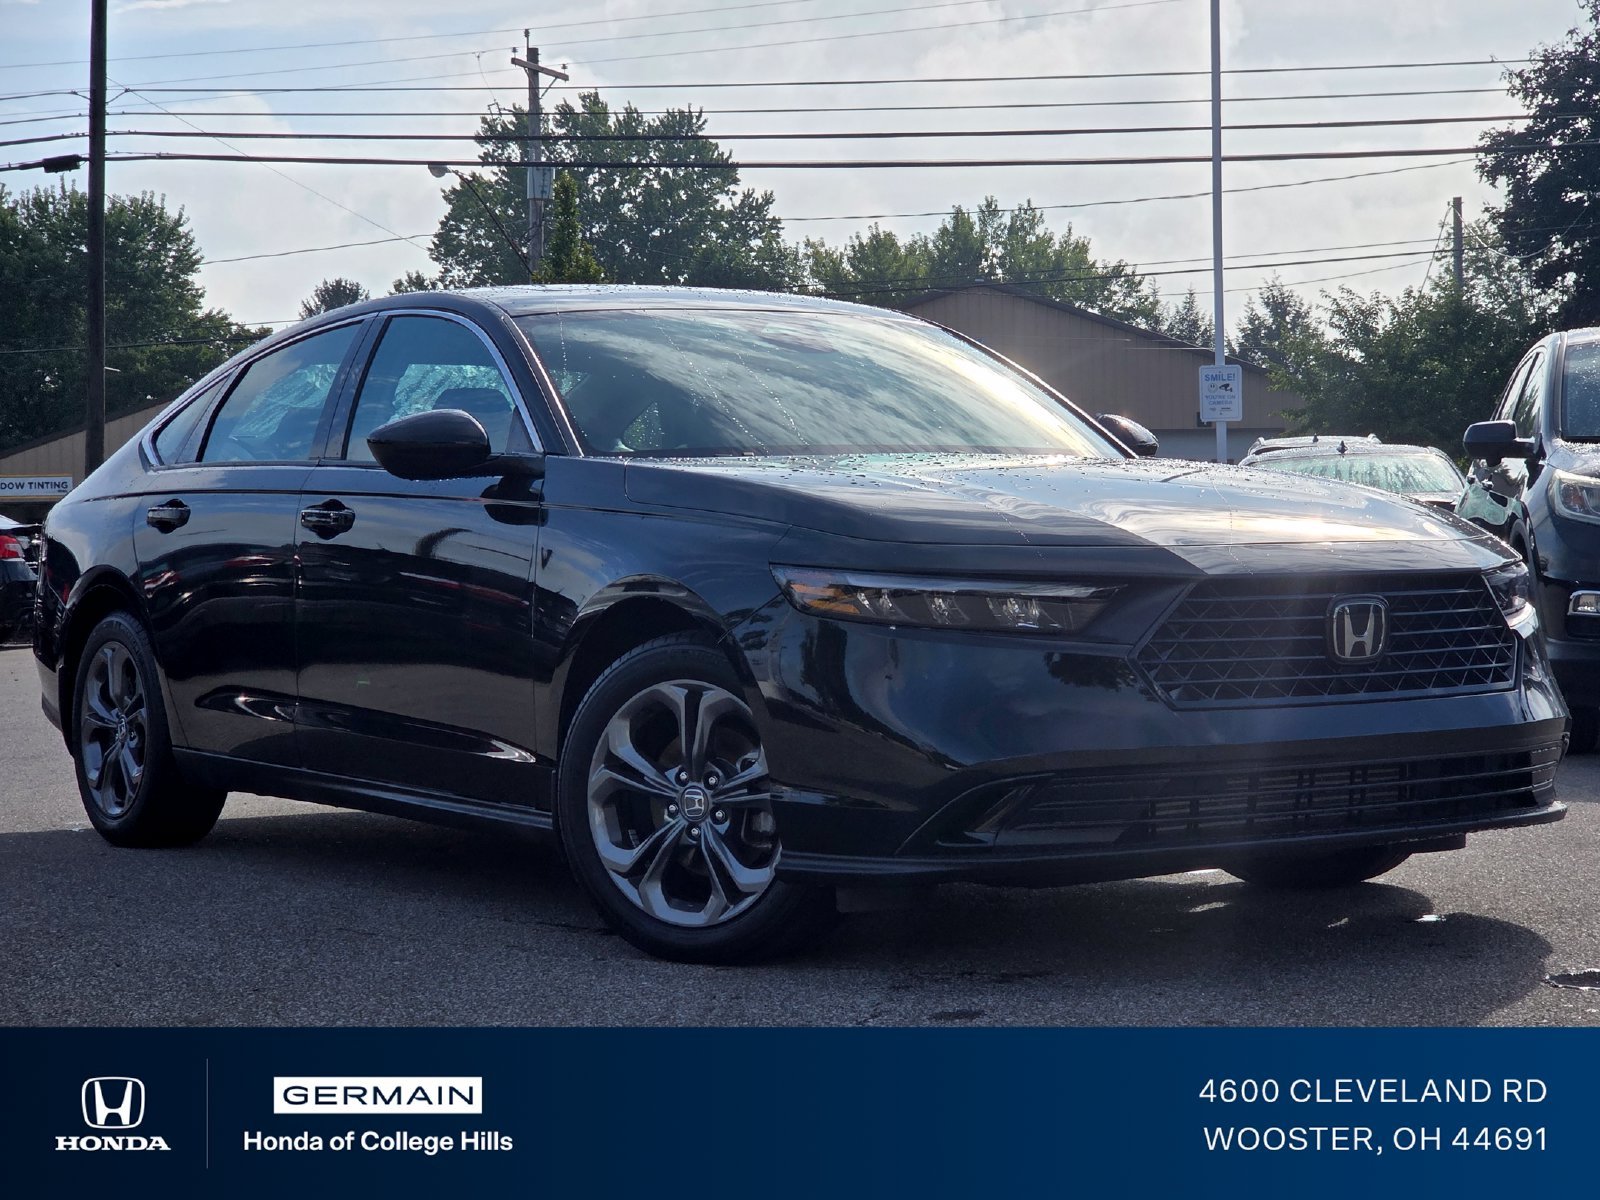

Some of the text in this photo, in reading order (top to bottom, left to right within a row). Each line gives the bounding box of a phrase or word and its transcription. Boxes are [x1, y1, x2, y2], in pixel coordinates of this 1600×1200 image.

[1204, 373, 1236, 382] SMILE!
[0, 481, 69, 490] DOW TINTING
